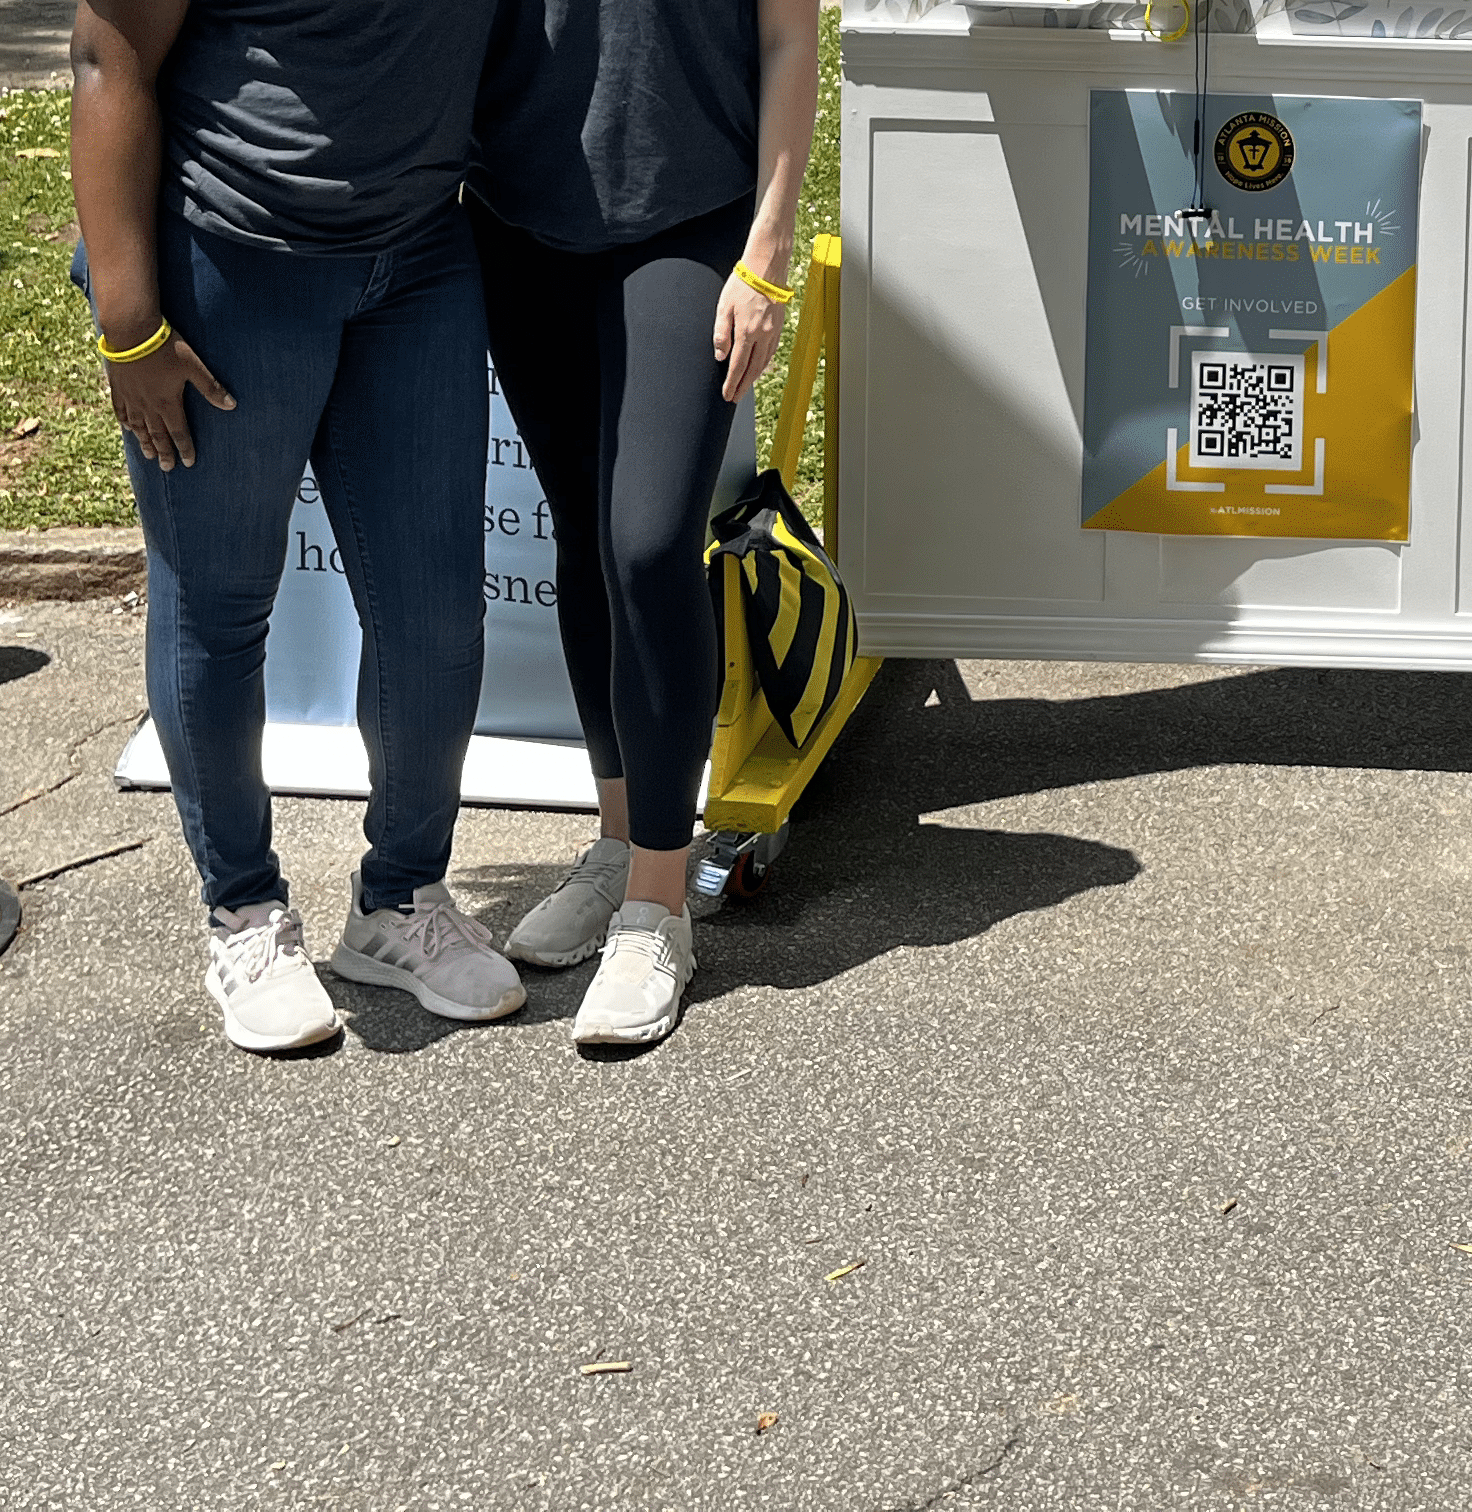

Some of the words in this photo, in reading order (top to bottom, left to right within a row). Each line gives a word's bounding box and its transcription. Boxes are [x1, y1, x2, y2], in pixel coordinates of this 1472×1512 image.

[1218, 114, 1256, 146] ATLANTA
[1259, 114, 1292, 147] MISSION
[1120, 212, 1244, 239] MENTAL
[1254, 218, 1374, 244] HEALTH
[1141, 239, 1301, 262] AWARENESS
[1308, 245, 1382, 265] WEEK
[1181, 296, 1220, 313] GET
[1224, 298, 1318, 315] INVOLVED
